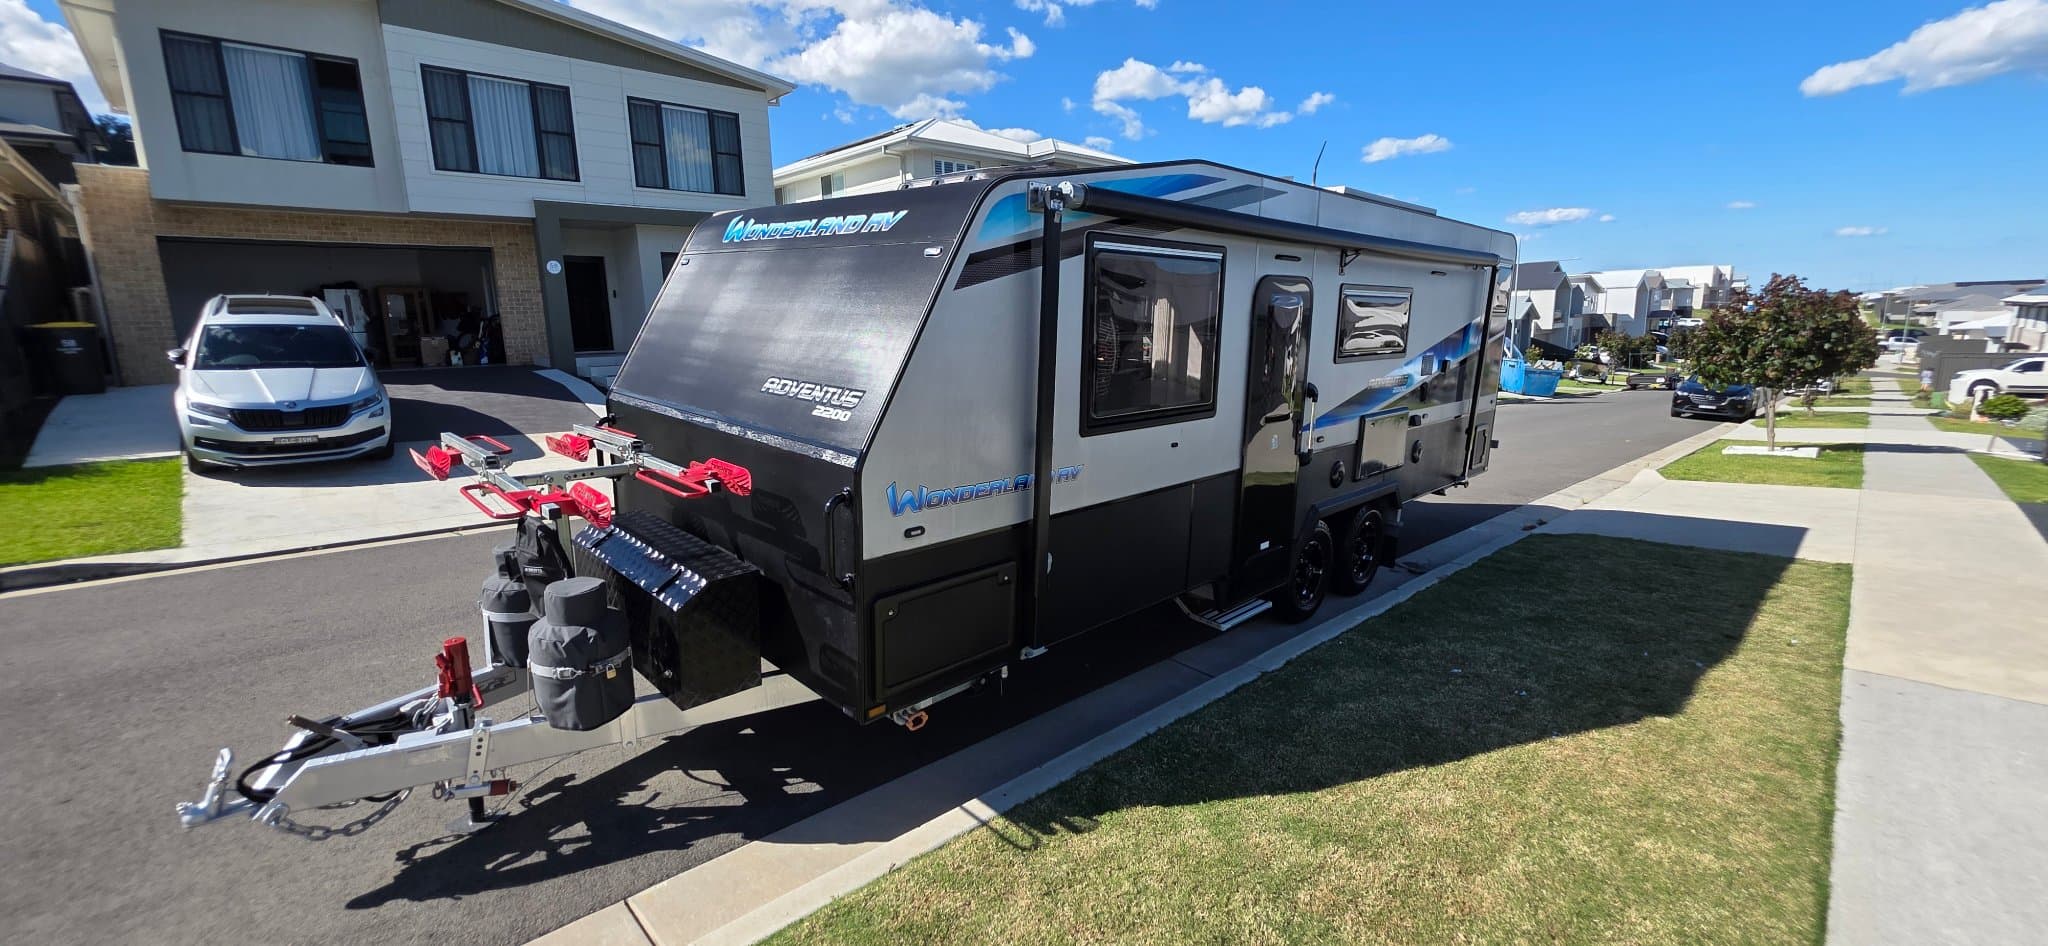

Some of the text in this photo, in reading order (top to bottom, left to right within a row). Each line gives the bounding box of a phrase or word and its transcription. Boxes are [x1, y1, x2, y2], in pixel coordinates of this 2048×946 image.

[722, 210, 909, 243] WONDERLAND RV
[761, 376, 865, 408] ADVENTUS
[811, 405, 852, 421] 2200
[1056, 464, 1085, 485] RV
